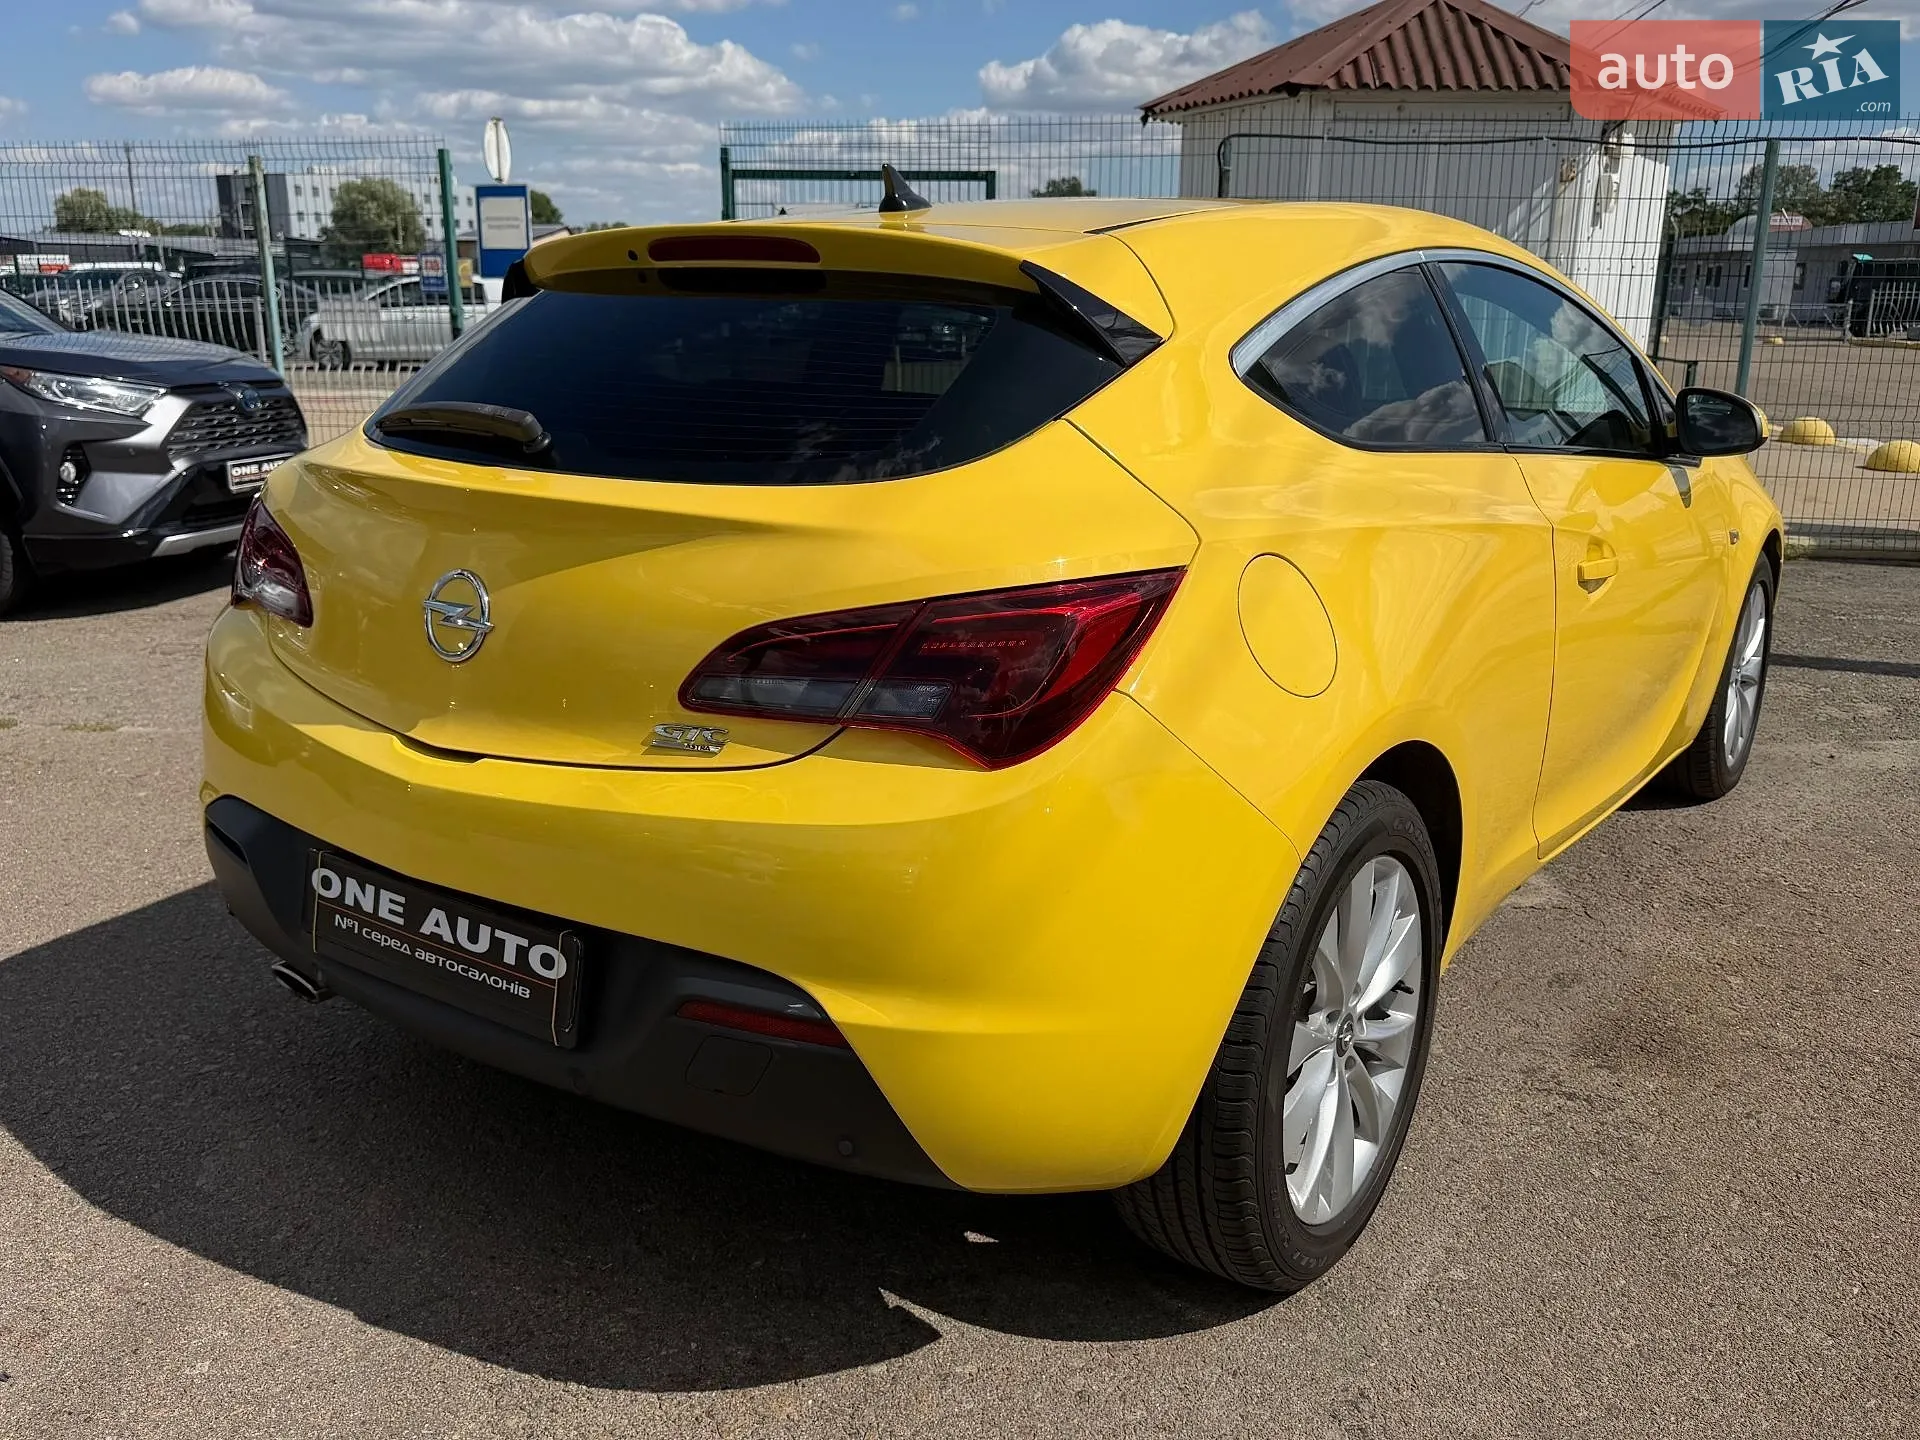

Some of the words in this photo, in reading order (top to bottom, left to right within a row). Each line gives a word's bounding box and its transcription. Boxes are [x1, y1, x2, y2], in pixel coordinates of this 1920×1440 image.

[232, 464, 259, 476] ONE
[654, 724, 730, 744] GTC
[311, 868, 406, 926] ONE
[420, 907, 568, 980] AUTO
[363, 927, 412, 955] серед
[415, 947, 531, 999] автосалонів
